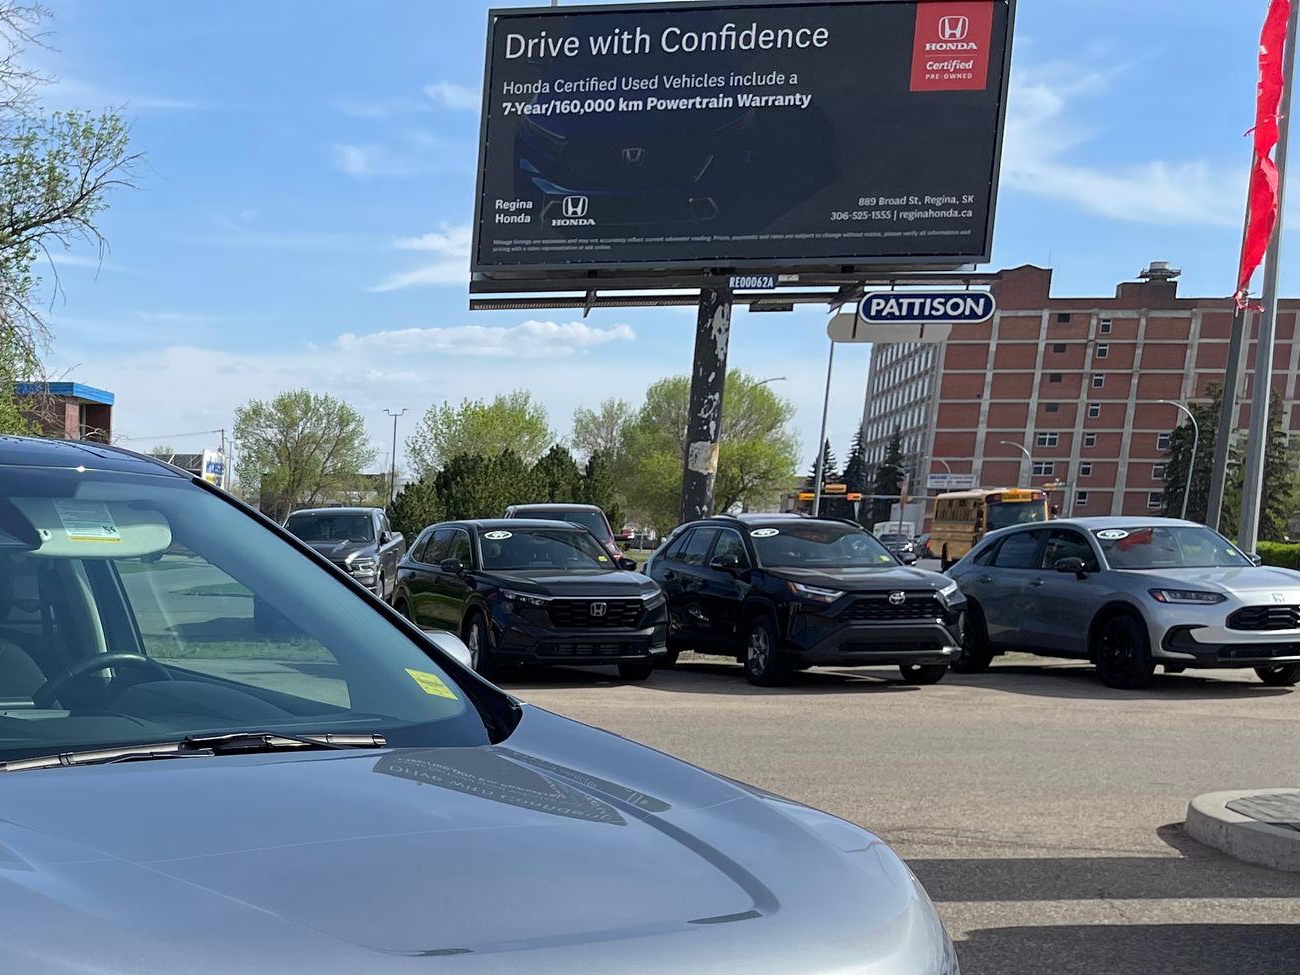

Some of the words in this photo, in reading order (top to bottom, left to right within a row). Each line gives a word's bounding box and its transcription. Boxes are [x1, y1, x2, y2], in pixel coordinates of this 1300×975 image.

[505, 31, 580, 59] Drive
[589, 27, 651, 55] with
[661, 22, 830, 52] Confidence
[924, 42, 978, 51] HONDA
[926, 59, 974, 72] Certified
[503, 80, 550, 95] Honda
[554, 76, 617, 93] Certified
[621, 75, 658, 91] Used
[663, 73, 725, 89] Vehicles
[730, 71, 785, 87] include
[789, 74, 798, 85] a
[502, 99, 615, 116] 7-Year/160,000
[618, 98, 643, 112] km
[646, 94, 733, 111] Powertrain
[737, 93, 812, 109] Warranty
[495, 199, 533, 211] Regina
[879, 196, 907, 206] Broad
[924, 195, 959, 206] Regina,
[962, 195, 975, 204] SK
[495, 213, 531, 224] Honda
[899, 209, 973, 221] reginahonda.ca
[551, 218, 596, 226] HONDA
[729, 276, 774, 288] RE00062A
[869, 297, 986, 317] PATTISON
